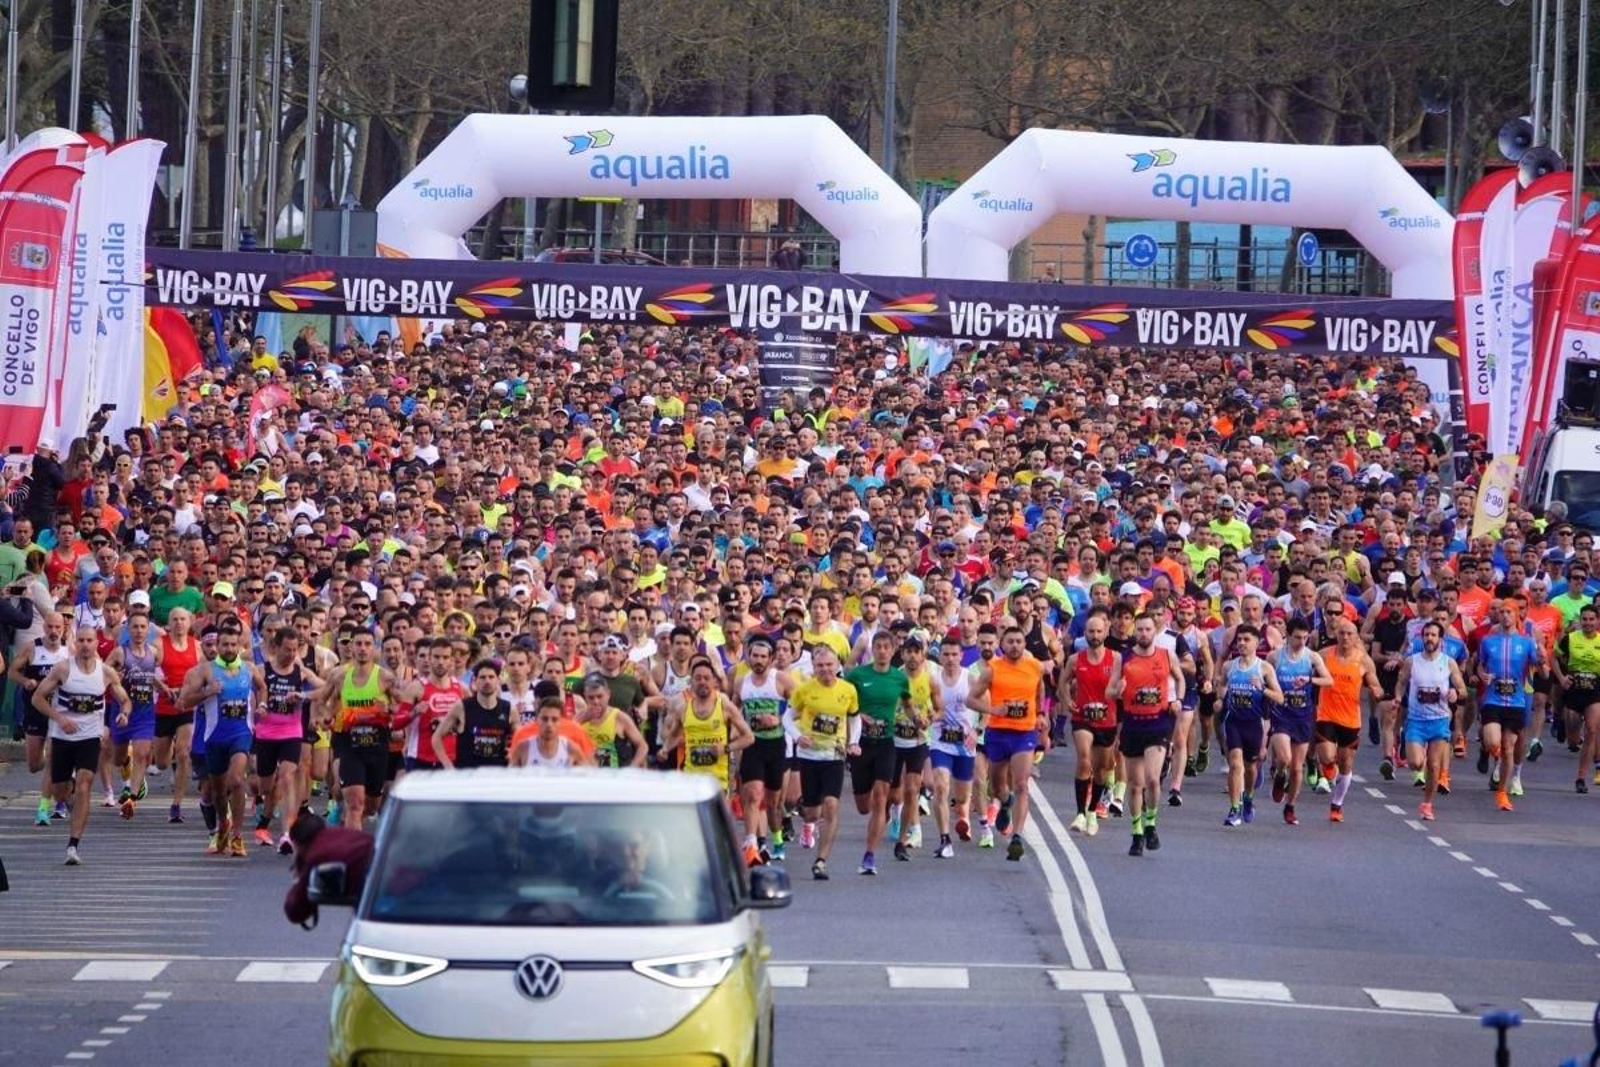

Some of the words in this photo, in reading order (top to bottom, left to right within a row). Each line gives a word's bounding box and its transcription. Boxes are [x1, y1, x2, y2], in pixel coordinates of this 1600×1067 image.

[589, 146, 731, 187] aqualia
[419, 183, 473, 201] aqualia
[826, 185, 880, 204] aqualia
[1152, 168, 1293, 207] aqualia
[979, 195, 1034, 213] aqualia
[1389, 214, 1441, 231] aqualia
[102, 223, 130, 320] aqualia
[3, 294, 24, 396] CONCELLO
[24, 308, 39, 359] VIGO
[21, 362, 34, 386] DE
